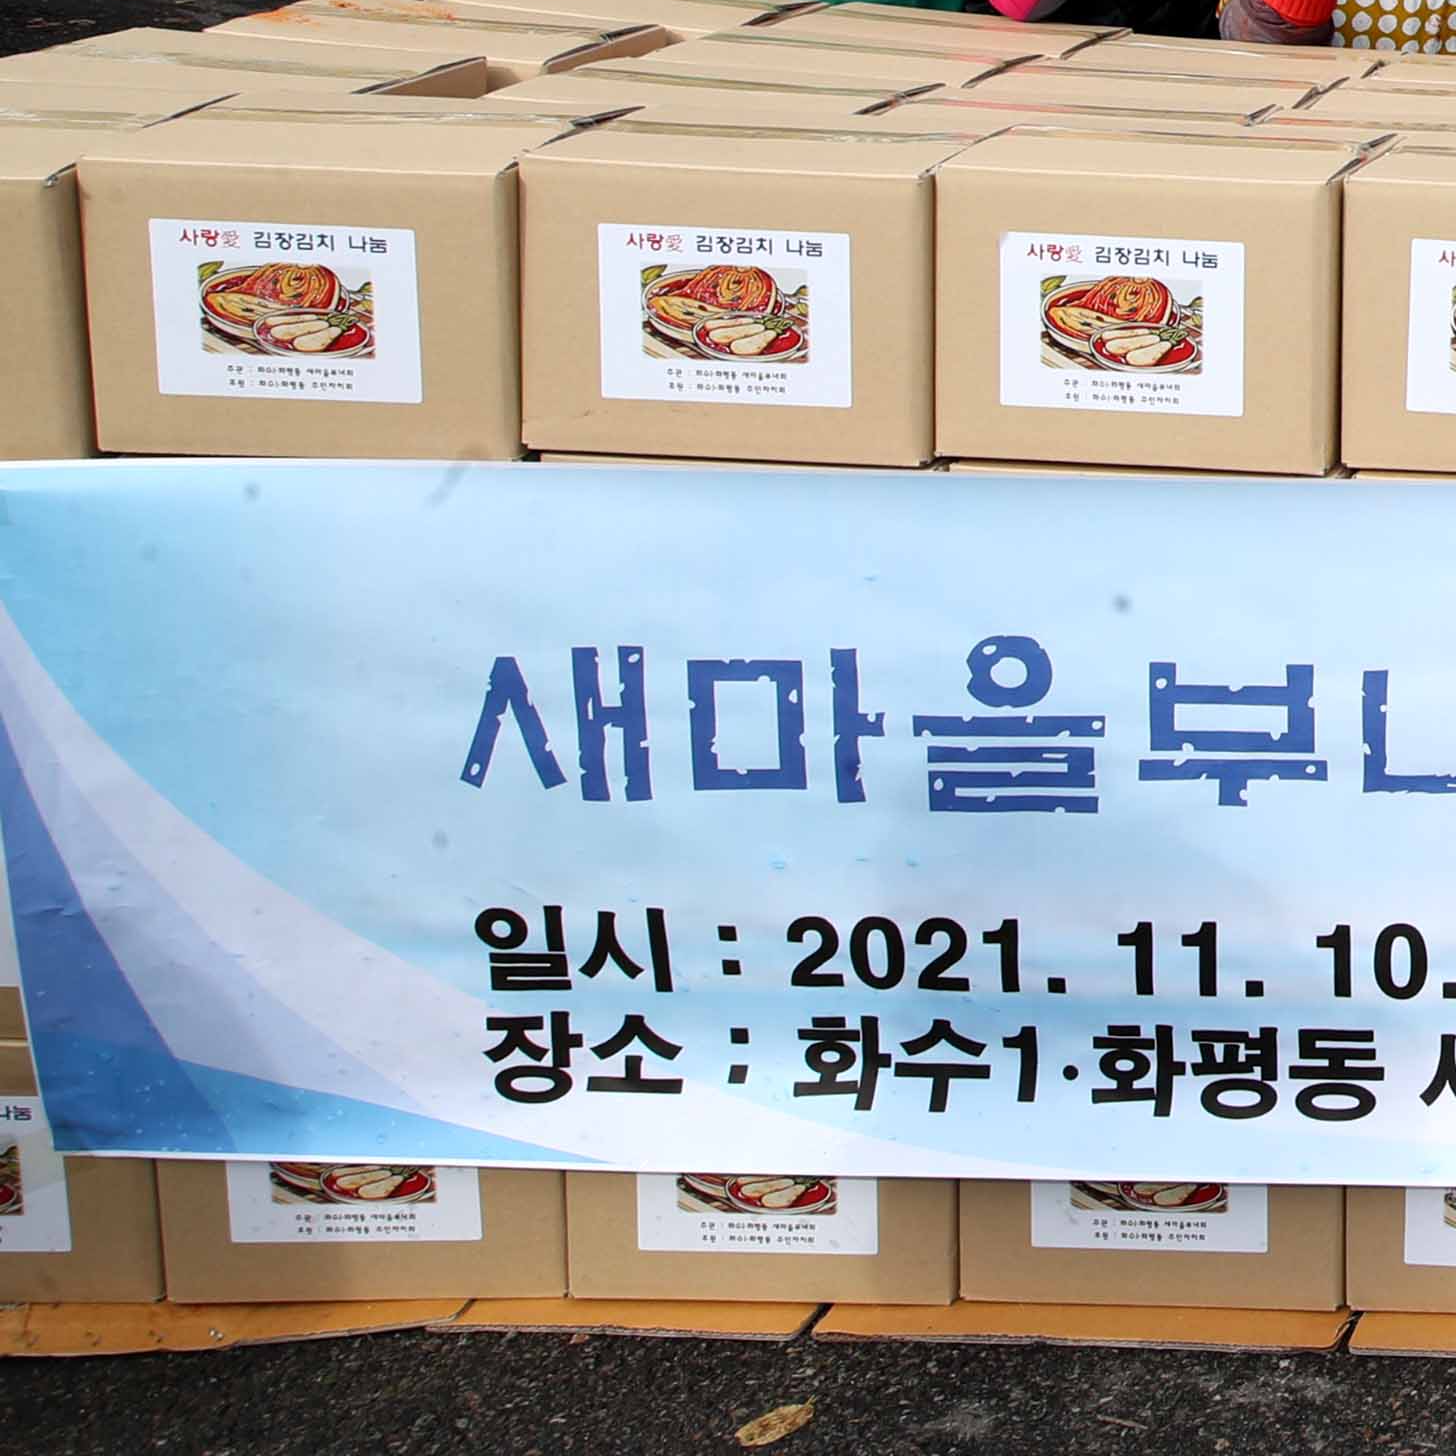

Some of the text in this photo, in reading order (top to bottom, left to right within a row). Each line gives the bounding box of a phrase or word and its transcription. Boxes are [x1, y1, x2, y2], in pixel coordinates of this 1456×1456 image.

[253, 231, 335, 252] 김장김치
[348, 235, 388, 254] 나눔
[696, 234, 773, 255] 김장김치
[785, 239, 823, 258] 나눔
[1095, 246, 1170, 267] 김장김치
[1182, 250, 1218, 269] 나눔
[475, 906, 672, 992] 일시
[484, 1011, 682, 1103] 장소
